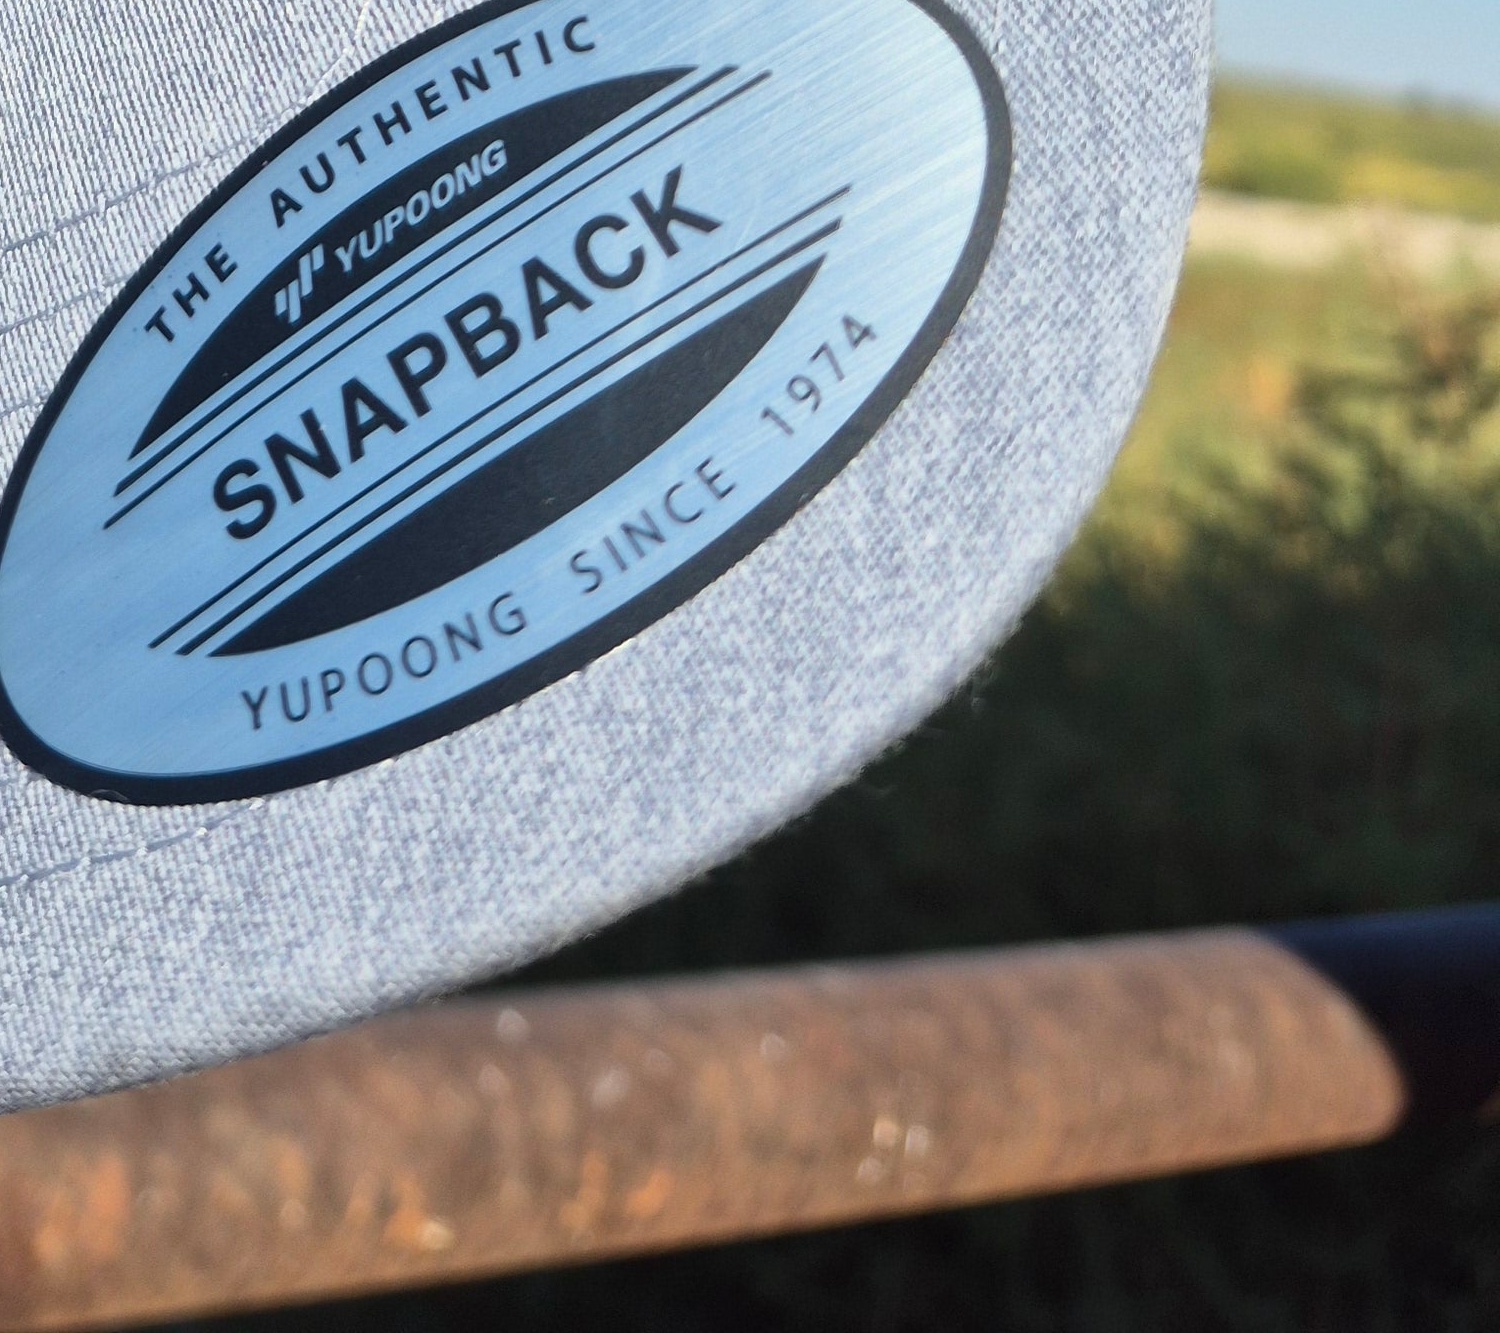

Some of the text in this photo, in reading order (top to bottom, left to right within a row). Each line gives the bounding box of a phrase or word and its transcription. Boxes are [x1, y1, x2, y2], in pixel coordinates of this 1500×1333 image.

[144, 16, 595, 344] THE AUTHENTIC
[212, 164, 723, 540] SNAPBACK
[334, 139, 509, 274] YUPOONG
[240, 314, 877, 732] YUPOONG SINCE 1974
